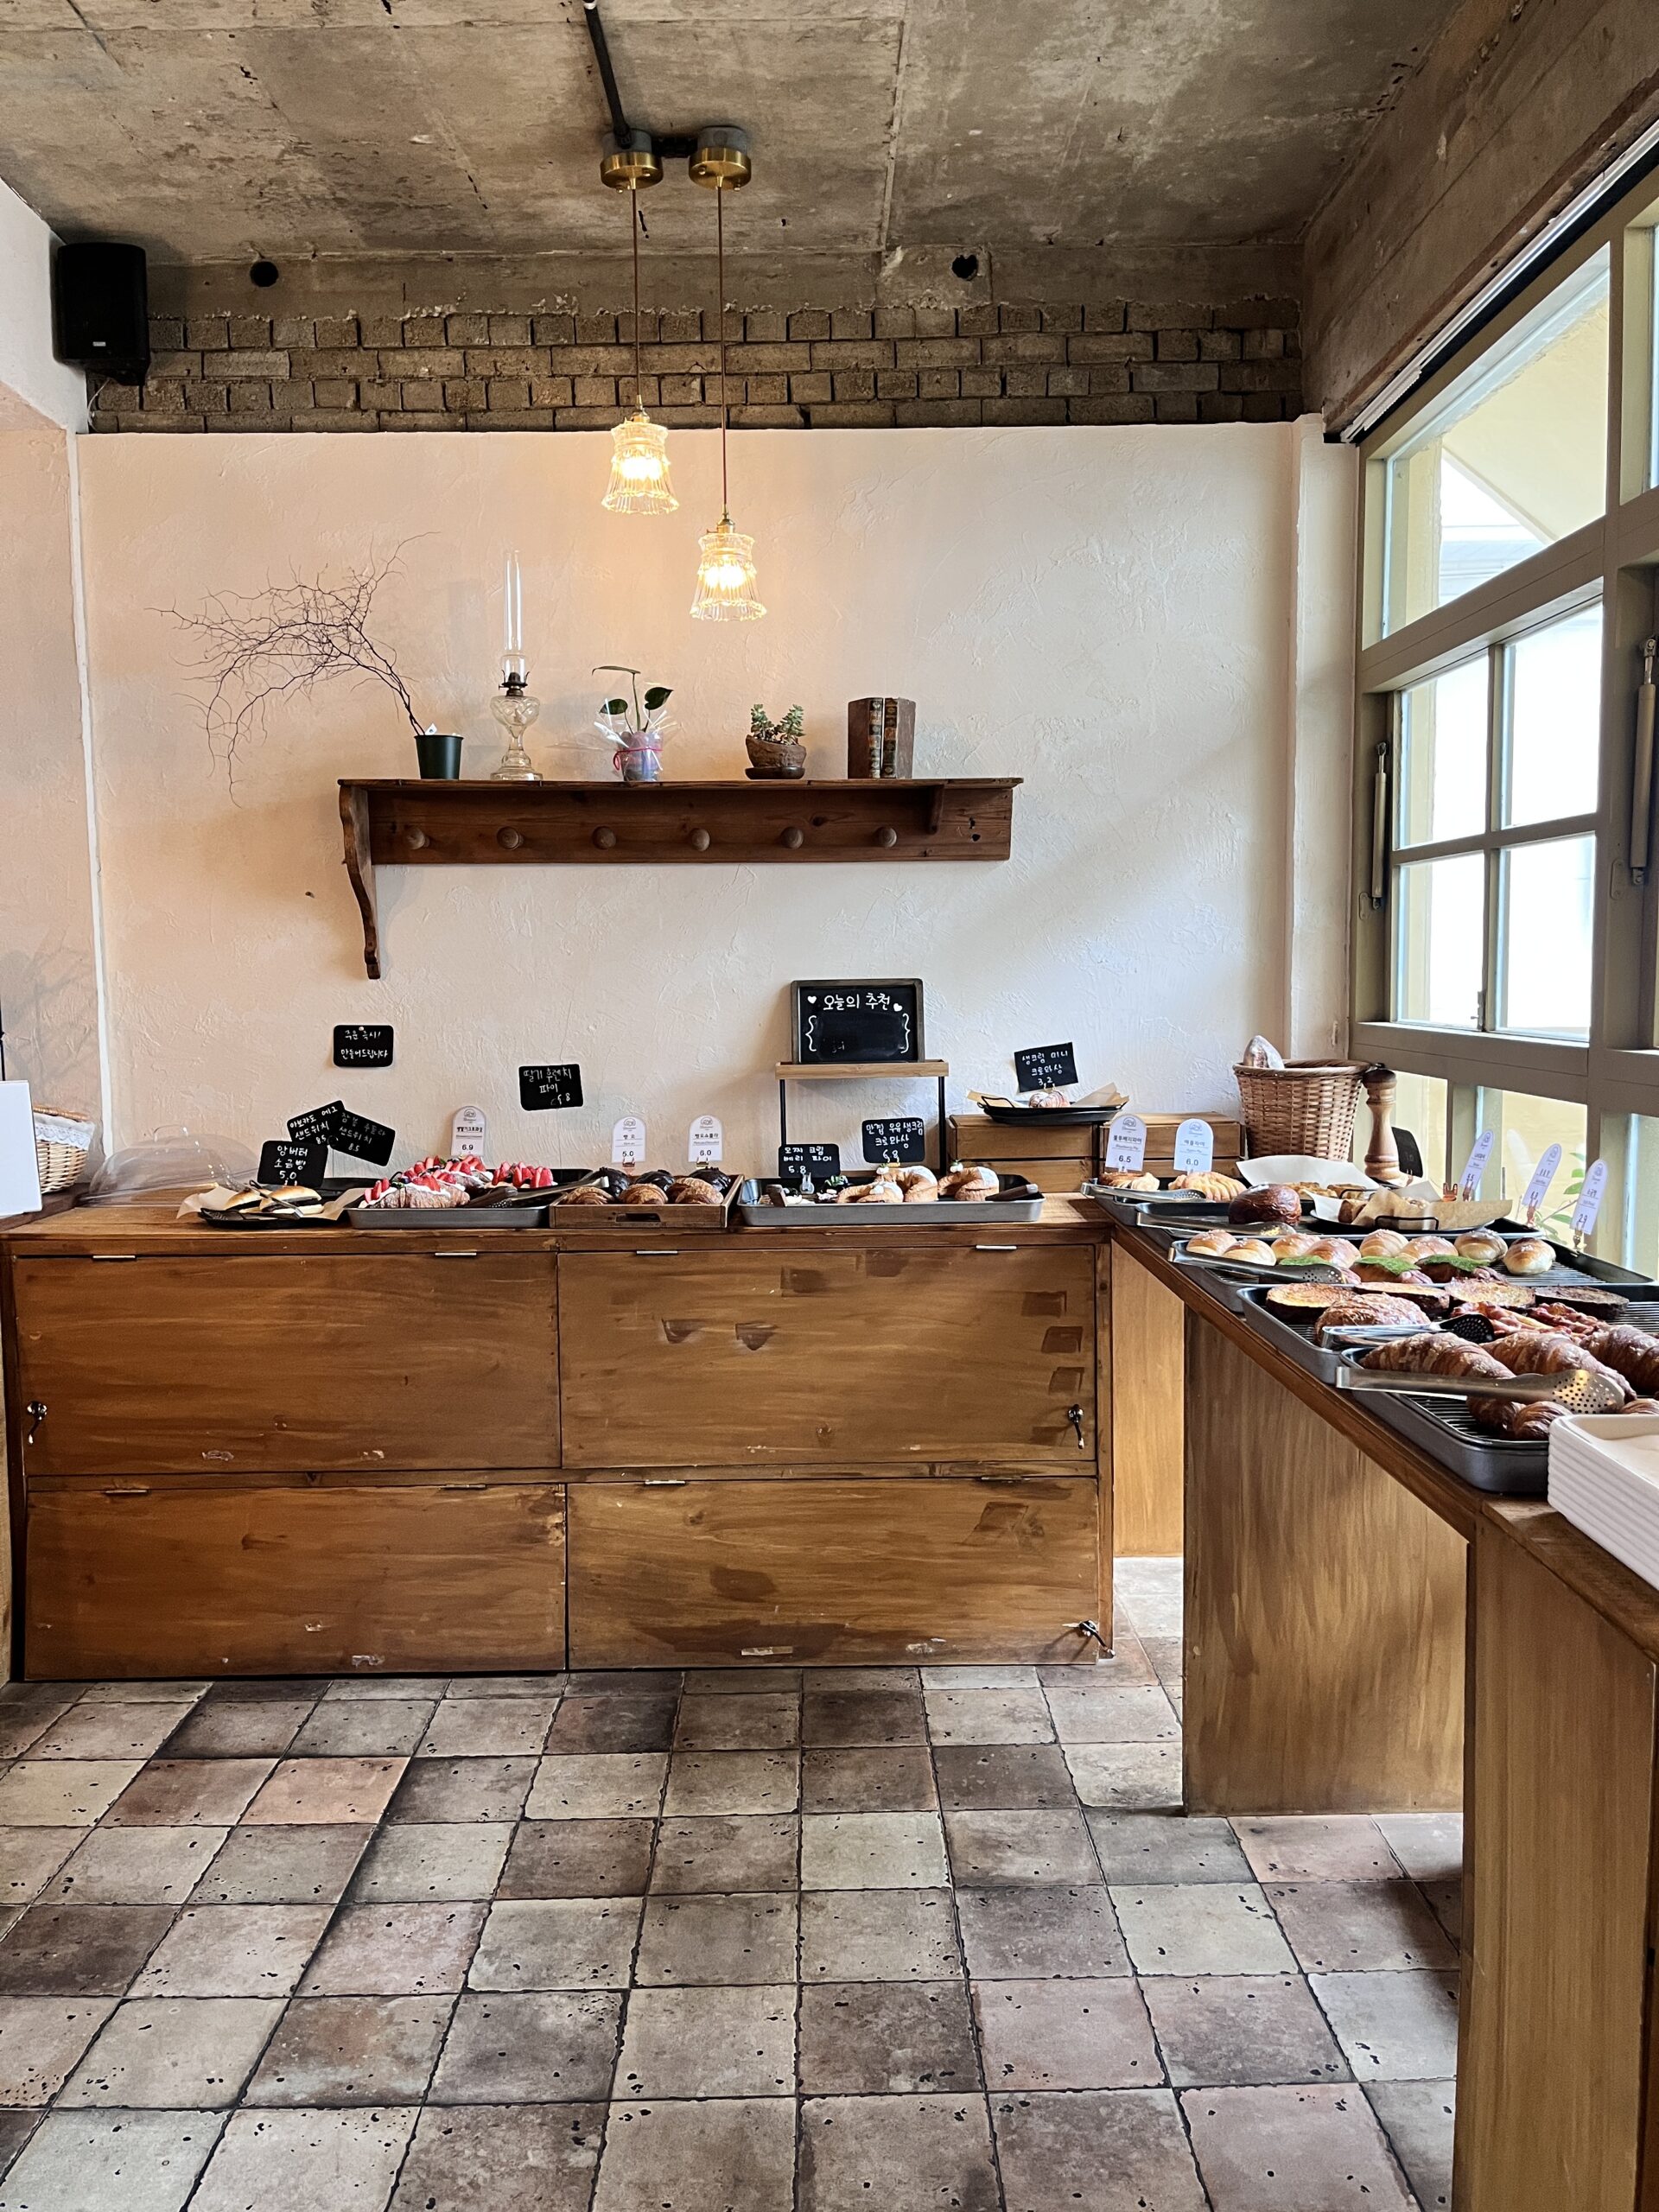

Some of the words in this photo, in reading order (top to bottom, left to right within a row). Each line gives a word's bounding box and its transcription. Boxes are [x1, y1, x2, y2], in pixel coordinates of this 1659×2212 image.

[823, 994, 860, 1011] 오늘의
[865, 992, 891, 1010] 추천
[340, 1048, 388, 1060] 만들어드립니다
[1022, 1052, 1046, 1065] 생크림
[1051, 1050, 1068, 1058] 미니
[523, 1069, 543, 1083] 딸기
[546, 1066, 572, 1084] 후렌치
[1031, 1064, 1063, 1077] 크로와상
[539, 1083, 558, 1094] 파이
[289, 1114, 317, 1128] 아보카도
[321, 1106, 338, 1116] 에그
[295, 1121, 330, 1140] 샌드위치
[866, 1122, 884, 1135] 만겹
[339, 1126, 372, 1144] 샌드위치
[874, 1134, 910, 1148] 크로와상
[276, 1145, 308, 1157] 앙버터
[348, 1143, 360, 1152] 8.5
[809, 1146, 824, 1156] 크림
[1118, 1154, 1131, 1163] 6.5
[1185, 1158, 1199, 1166] 6.0
[274, 1159, 306, 1171] 소금빵
[788, 1165, 806, 1174] 5.8
[279, 1170, 296, 1180] 5.0
